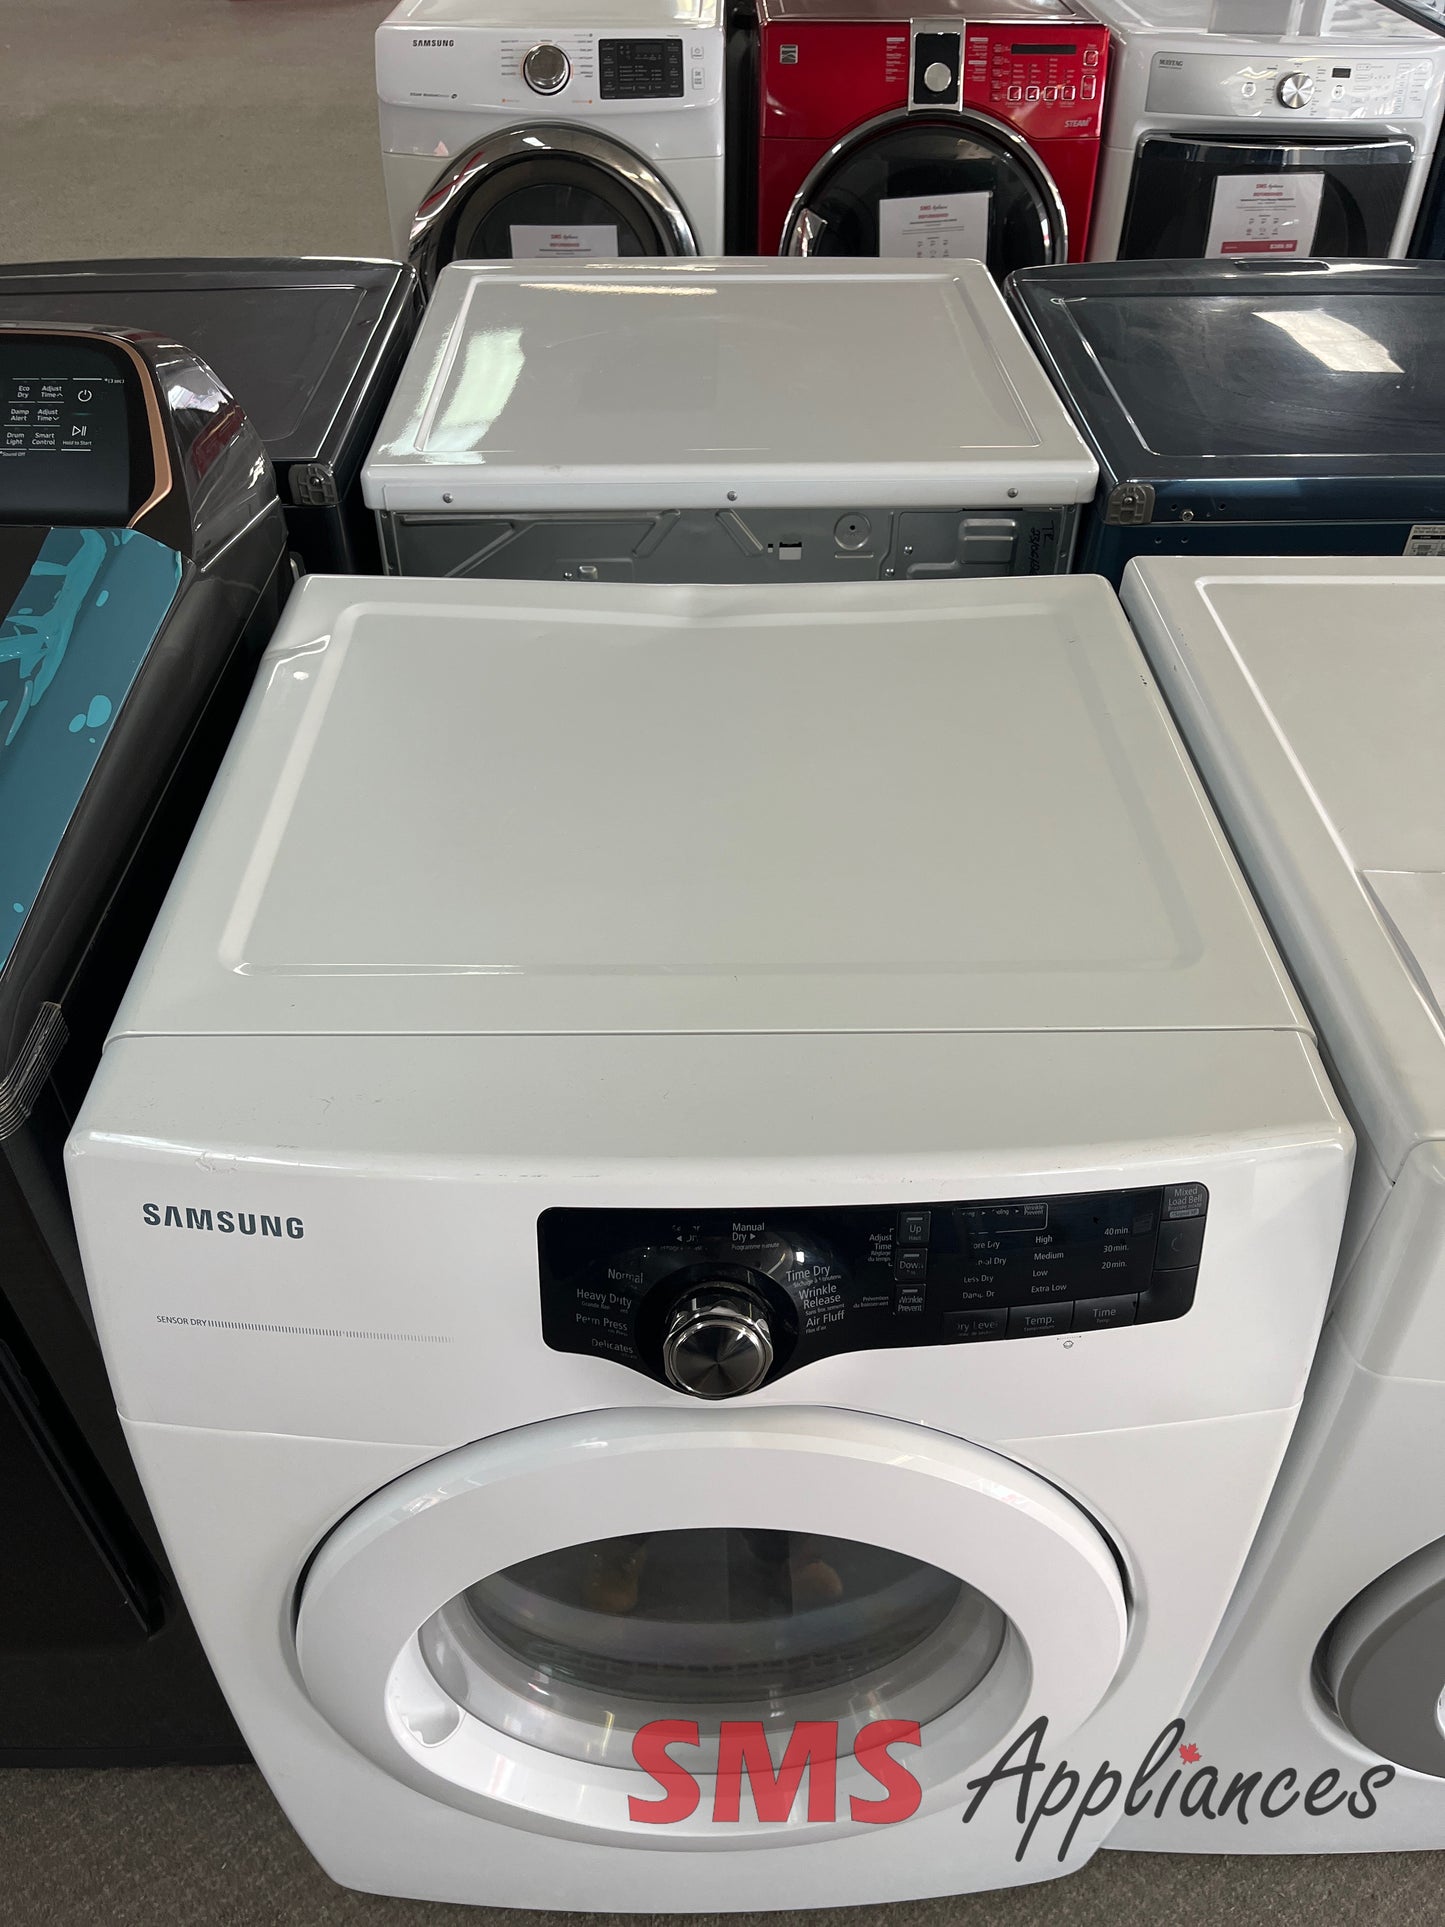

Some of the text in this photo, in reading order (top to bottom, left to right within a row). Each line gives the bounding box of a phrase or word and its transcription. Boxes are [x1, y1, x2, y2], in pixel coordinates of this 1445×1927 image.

[412, 39, 455, 47] SAMSUNG
[1174, 1187, 1198, 1197] Mixed
[1168, 1194, 1202, 1206] Load Bell
[142, 1202, 305, 1240] SAMSUNG
[732, 1222, 765, 1232] Manual
[909, 1224, 922, 1234] Up
[732, 1232, 747, 1243] Dry
[869, 1234, 892, 1242] Adjust
[1035, 1235, 1053, 1245] High
[987, 1240, 1000, 1250] Dry
[994, 1257, 1007, 1266] Dry
[1034, 1252, 1064, 1261] Medium
[608, 1268, 643, 1284] Normal
[786, 1270, 810, 1282] Time
[813, 1266, 830, 1276] Dry
[981, 1274, 994, 1283] Dry
[799, 1283, 837, 1300] Wrinkle
[576, 1288, 632, 1309] Heavy Duty
[804, 1294, 841, 1310] Release
[1093, 1308, 1117, 1317] Time
[156, 1315, 207, 1327] SENSOR DRY
[576, 1313, 628, 1331] Perm Press
[806, 1310, 845, 1328] Air Fluff
[1024, 1316, 1055, 1326] Temp.
[591, 1338, 634, 1353] Delicates
